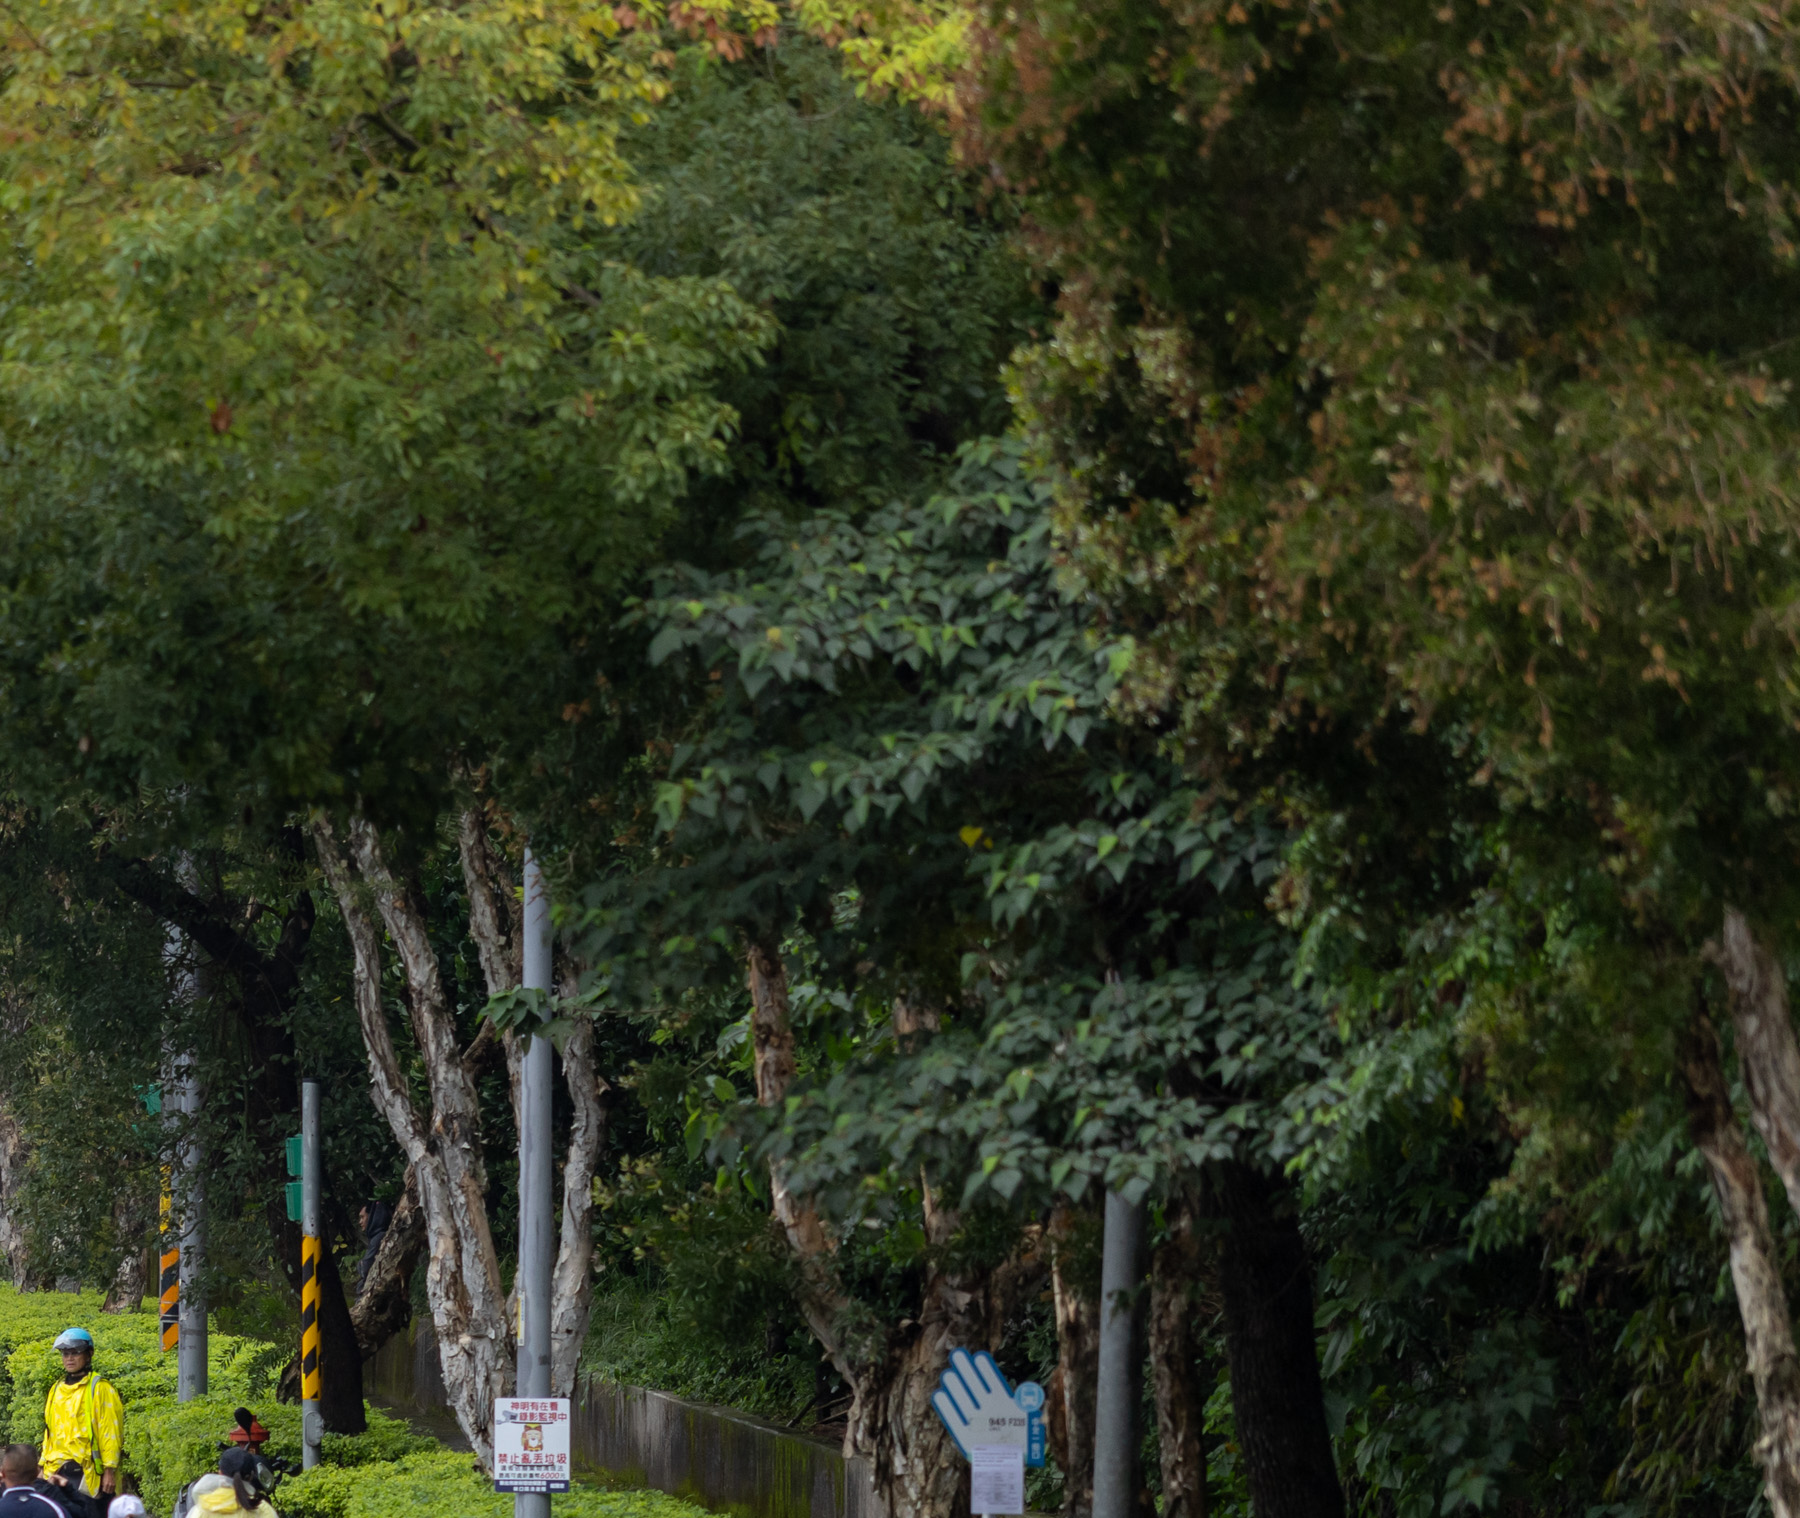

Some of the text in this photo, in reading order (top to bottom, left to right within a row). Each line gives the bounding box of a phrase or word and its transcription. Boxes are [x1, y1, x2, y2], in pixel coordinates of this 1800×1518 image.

[498, 1453, 567, 1464] 禁止亂丟垃圾
